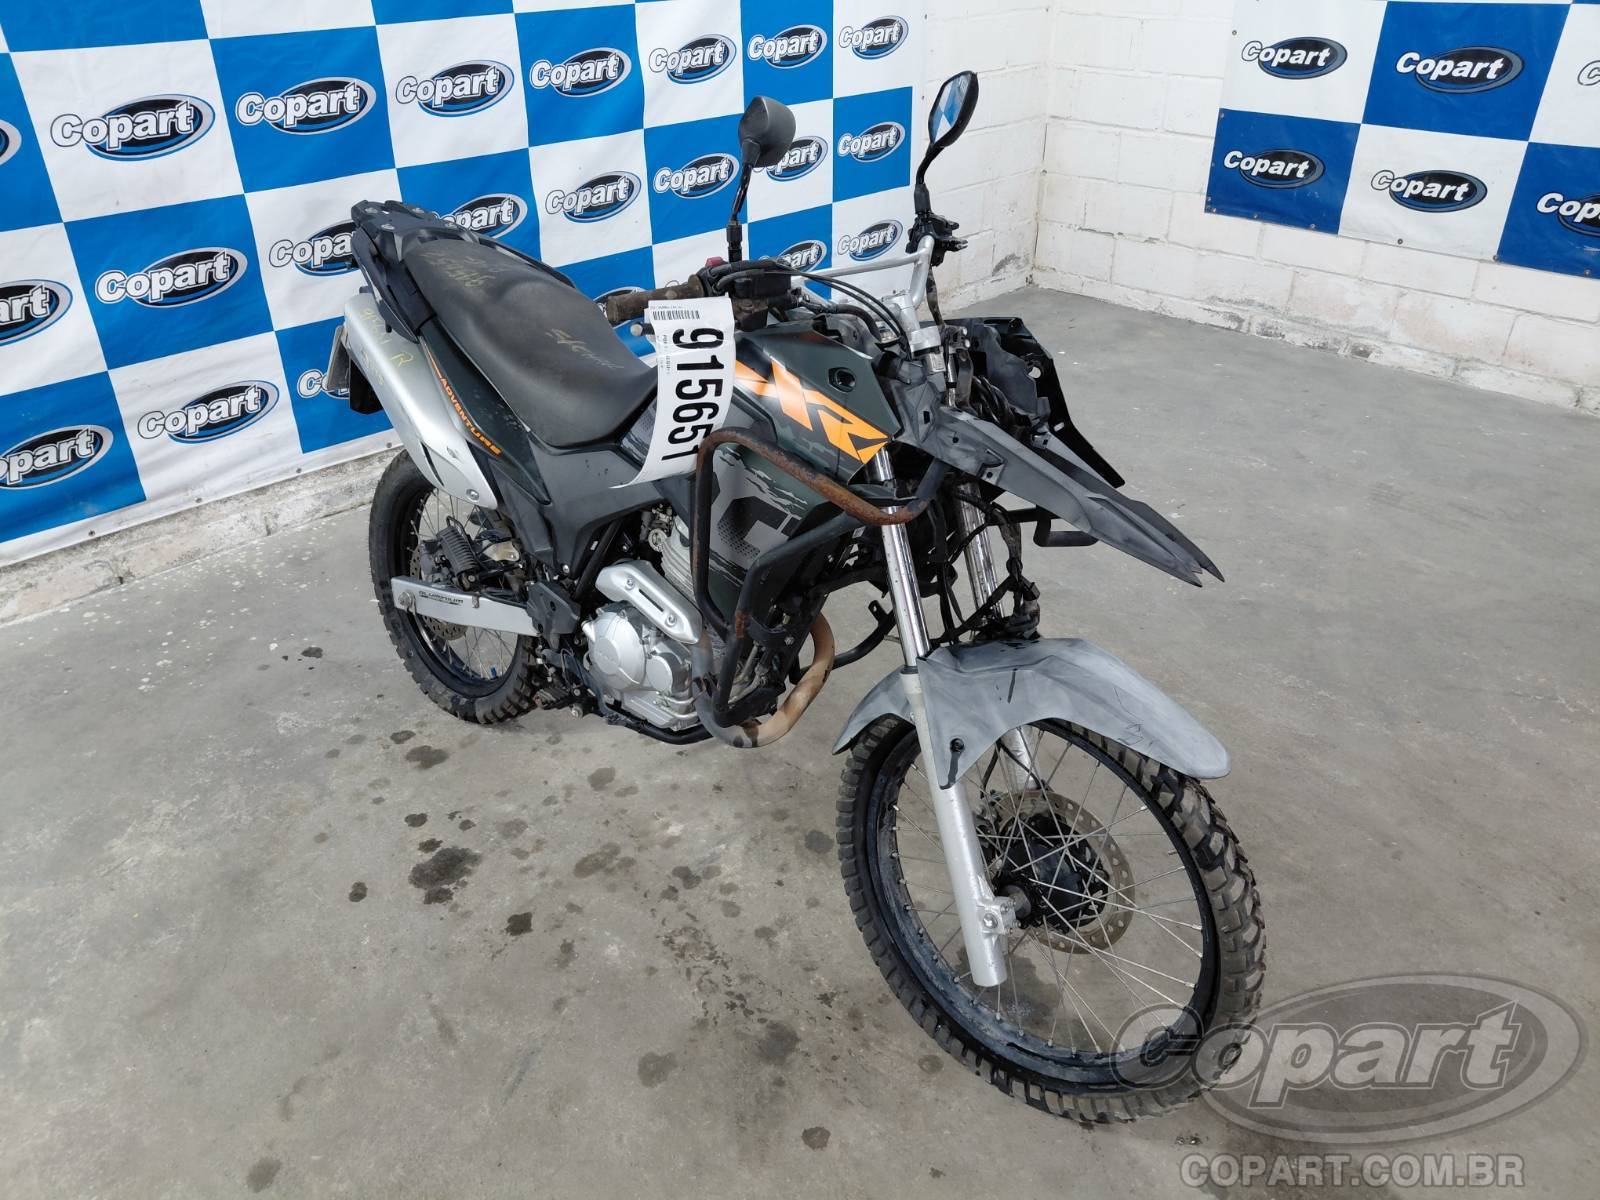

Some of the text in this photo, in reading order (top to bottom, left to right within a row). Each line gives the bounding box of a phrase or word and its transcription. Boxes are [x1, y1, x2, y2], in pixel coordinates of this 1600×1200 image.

[747, 26, 822, 64] Copart
[838, 18, 901, 53] Copart
[1241, 40, 1331, 69] Copart
[529, 50, 619, 91] Copart
[648, 37, 724, 76] Copart
[1395, 50, 1506, 81] Copart
[236, 81, 362, 128] Copart
[396, 65, 500, 108] Copart
[50, 101, 197, 150] Copart
[837, 125, 899, 158] Copart
[653, 154, 733, 196] Copart
[753, 140, 820, 175] part
[1223, 149, 1311, 180] Copart
[545, 172, 637, 217] Copart
[1370, 169, 1469, 202] Copart
[1536, 192, 1600, 223] Cop
[269, 230, 353, 273] Copa
[837, 223, 895, 256] Copart
[95, 249, 232, 304] Copart
[137, 381, 263, 439] Copart
[662, 327, 725, 461] 915651
[440, 377, 502, 458] ADVENTURE
[0, 427, 95, 485] part
